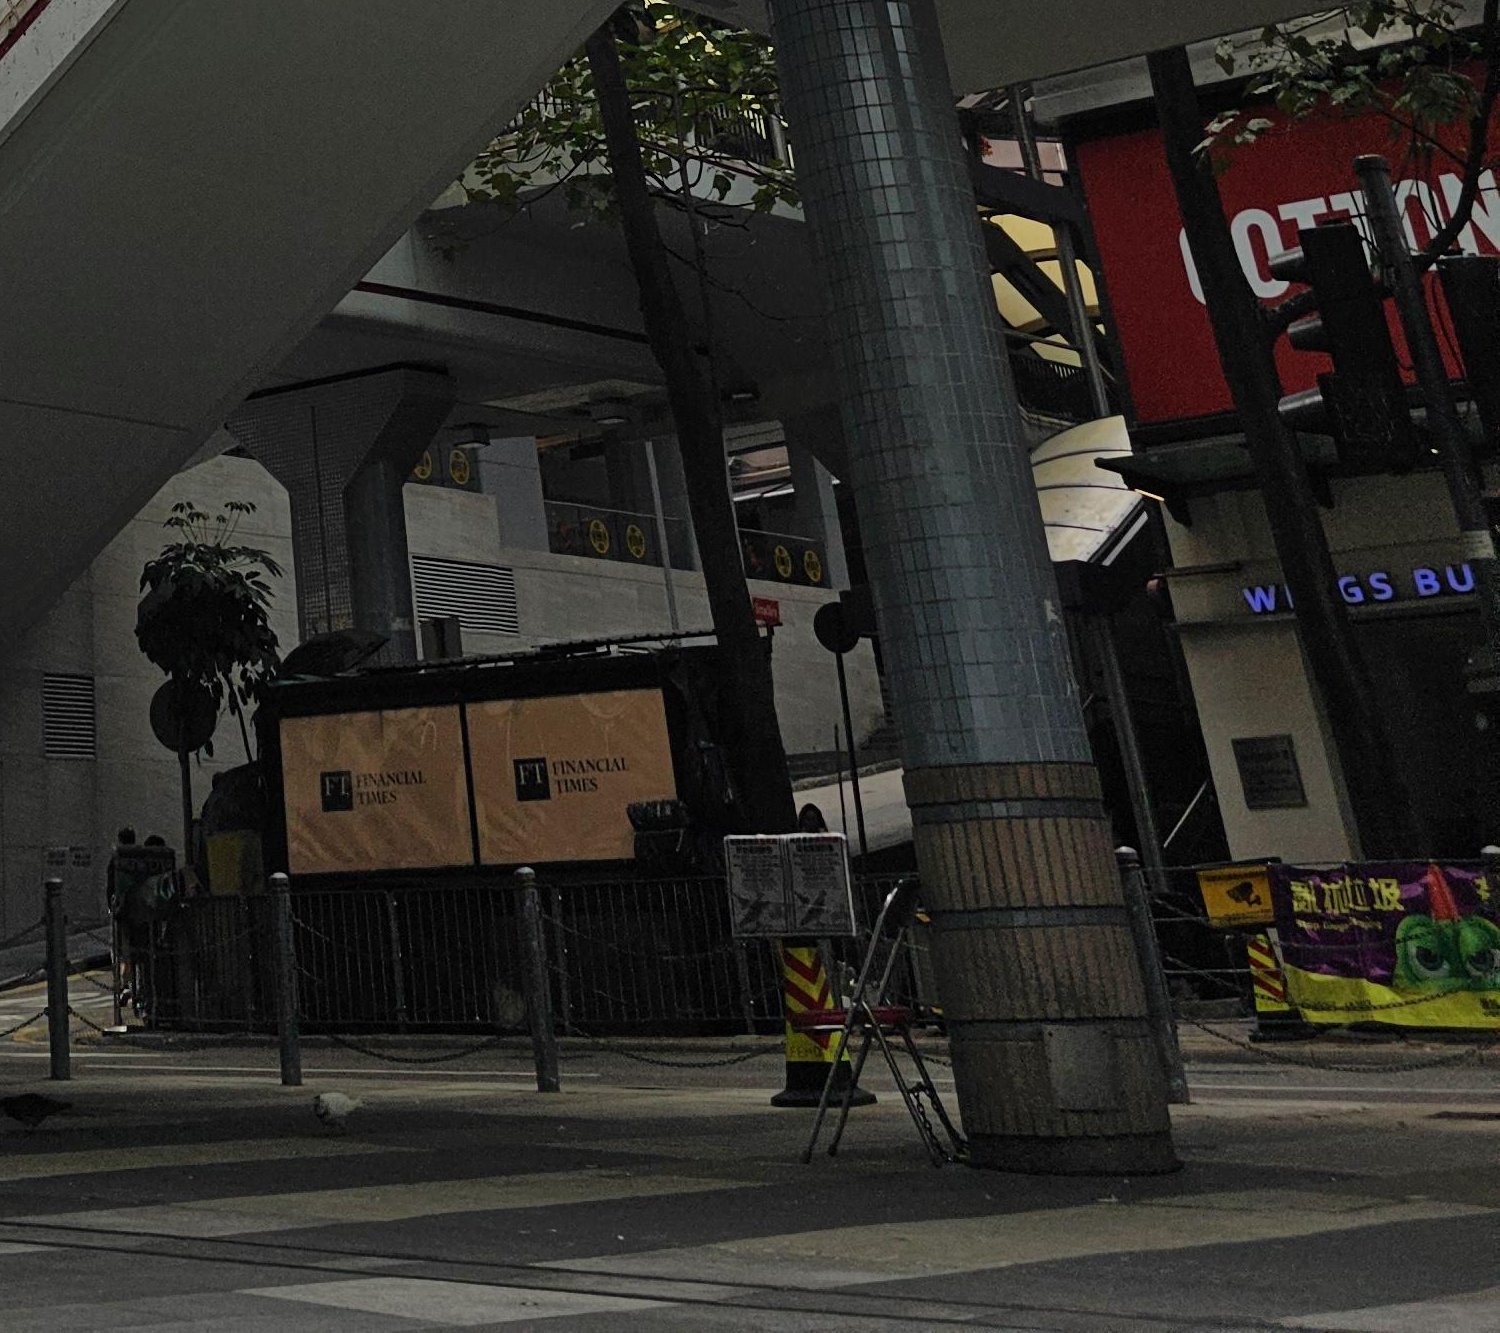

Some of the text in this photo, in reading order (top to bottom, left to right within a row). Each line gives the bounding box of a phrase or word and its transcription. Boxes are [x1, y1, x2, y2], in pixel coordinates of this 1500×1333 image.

[1242, 571, 1394, 613] WIGS
[518, 762, 544, 787] FT
[551, 757, 630, 775] FINANCIAL
[323, 774, 349, 798] FT
[356, 770, 427, 787] FINANCIAL
[556, 777, 598, 793] TIMES
[357, 790, 397, 805] TIMES
